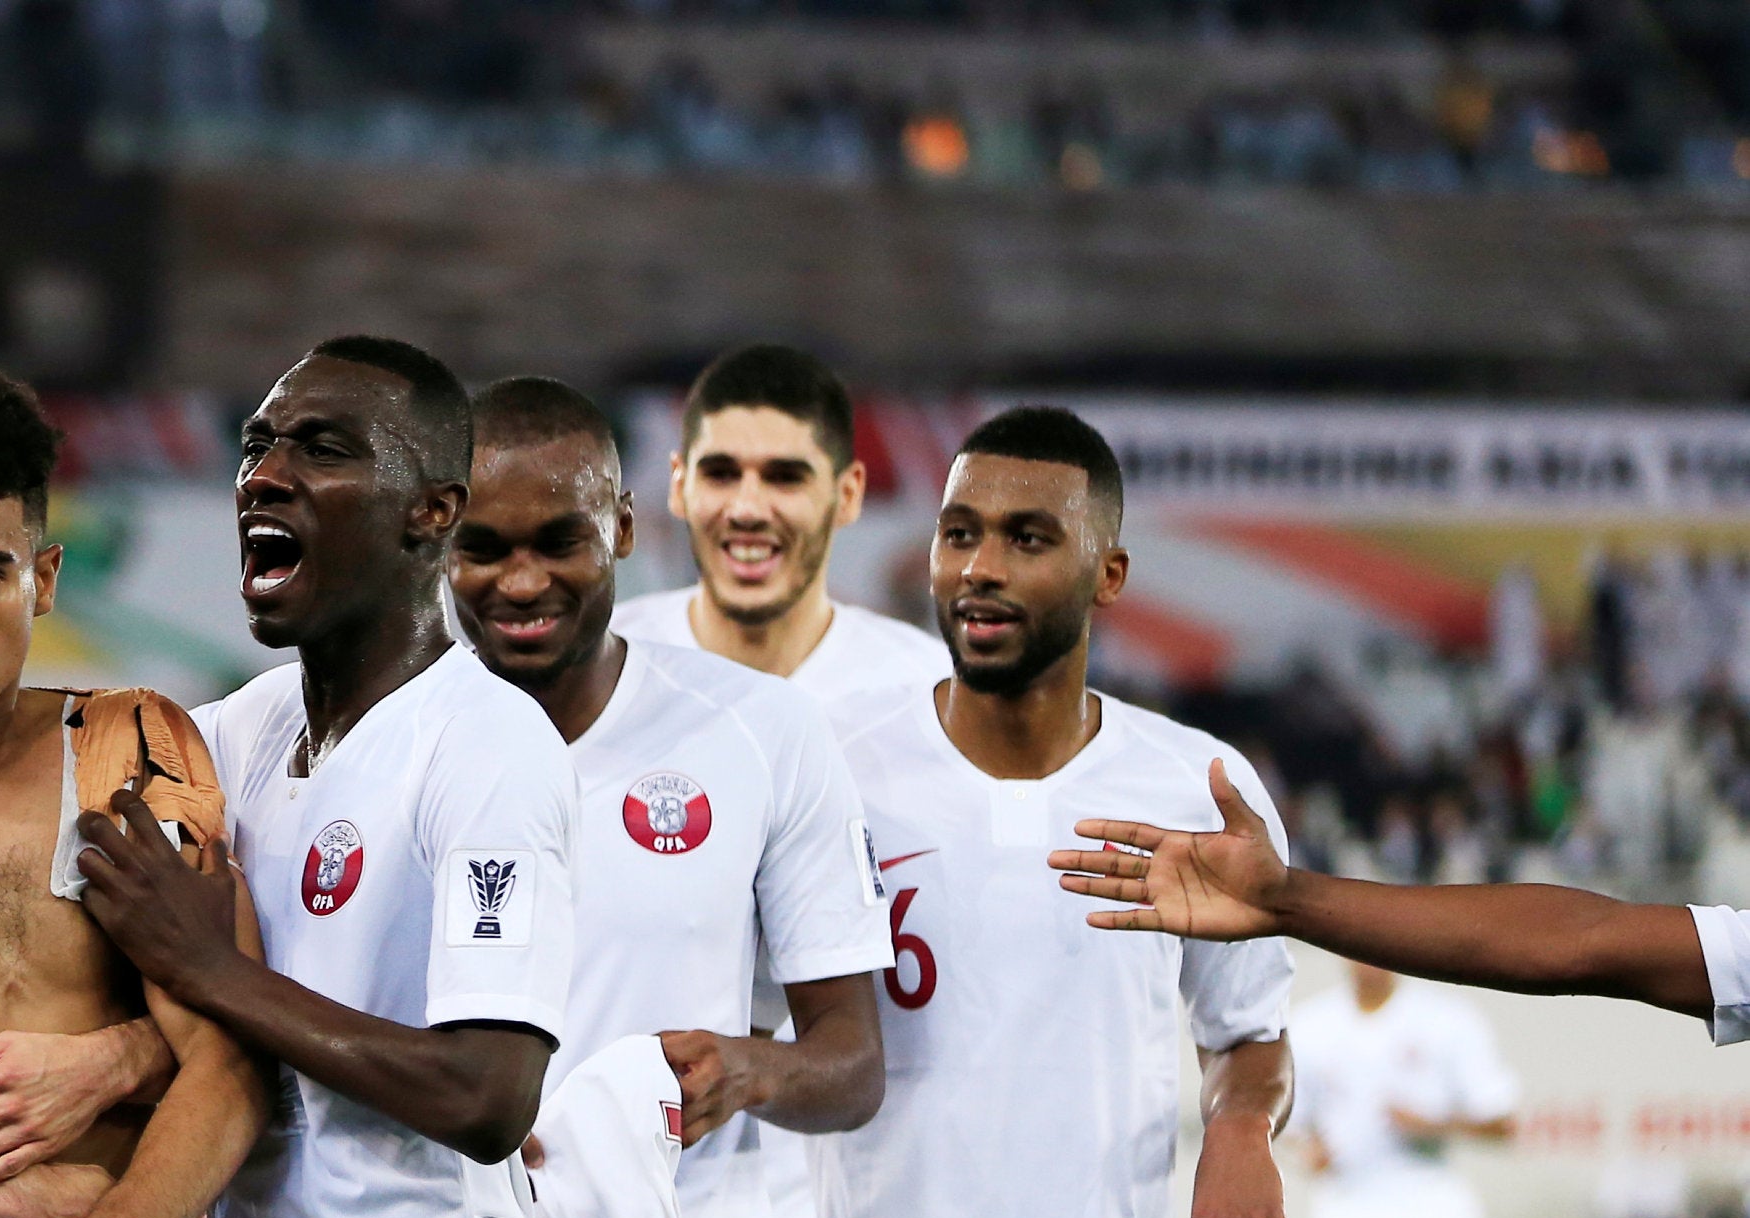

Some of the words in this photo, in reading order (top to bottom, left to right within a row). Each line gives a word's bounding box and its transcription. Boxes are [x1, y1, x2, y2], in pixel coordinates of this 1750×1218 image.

[653, 835, 688, 852] QFA
[312, 893, 335, 910] QFA
[884, 887, 938, 1011] 6
